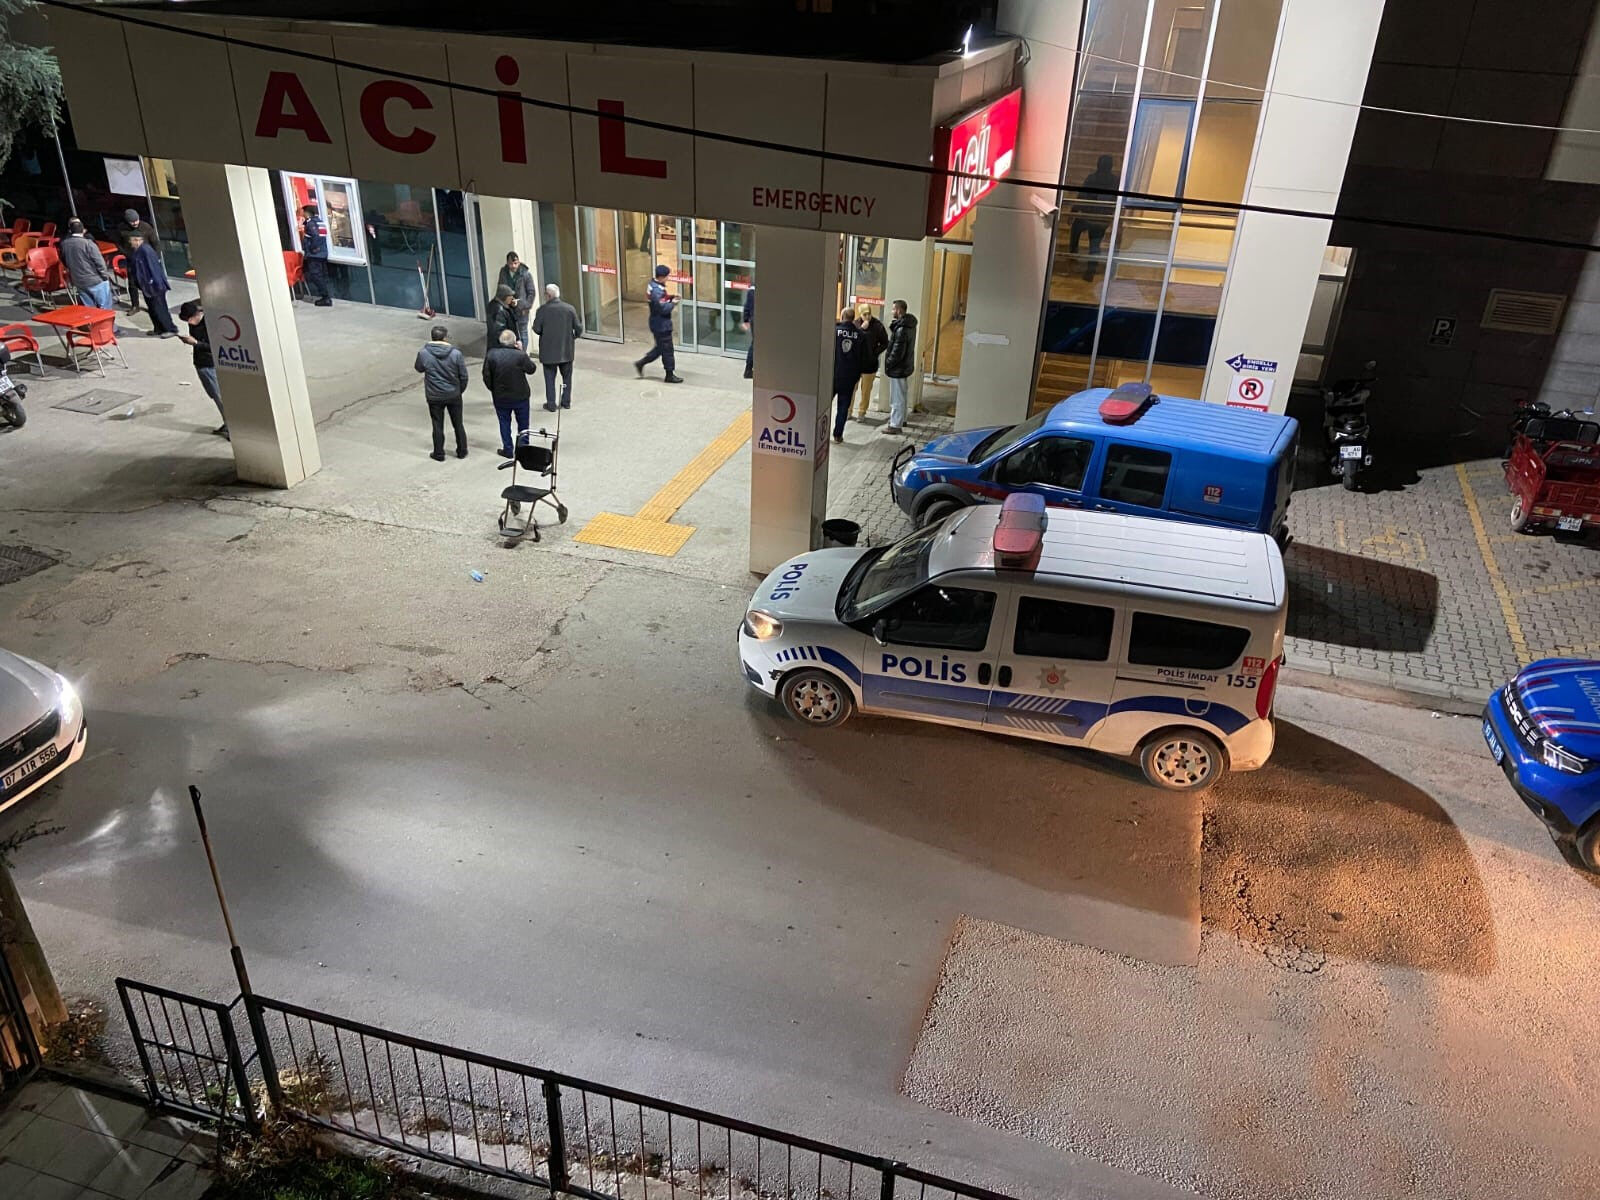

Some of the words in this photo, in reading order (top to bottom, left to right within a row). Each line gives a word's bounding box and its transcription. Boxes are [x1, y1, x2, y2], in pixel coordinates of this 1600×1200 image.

[255, 54, 667, 179] ACİL
[944, 112, 991, 225] ACİL
[753, 186, 876, 218] EMERGENCY
[218, 344, 256, 364] ACİL
[760, 427, 806, 448] ACİL
[1207, 486, 1221, 497] 112
[770, 563, 808, 601] POLİS
[881, 653, 967, 684] POLİS
[1157, 667, 1185, 679] POLİS
[1187, 671, 1219, 683] İMDAT
[1246, 658, 1262, 668] 112
[1226, 673, 1257, 689] 155
[5, 772, 16, 786] 07
[20, 760, 37, 777] AIR
[39, 747, 56, 764] 556
